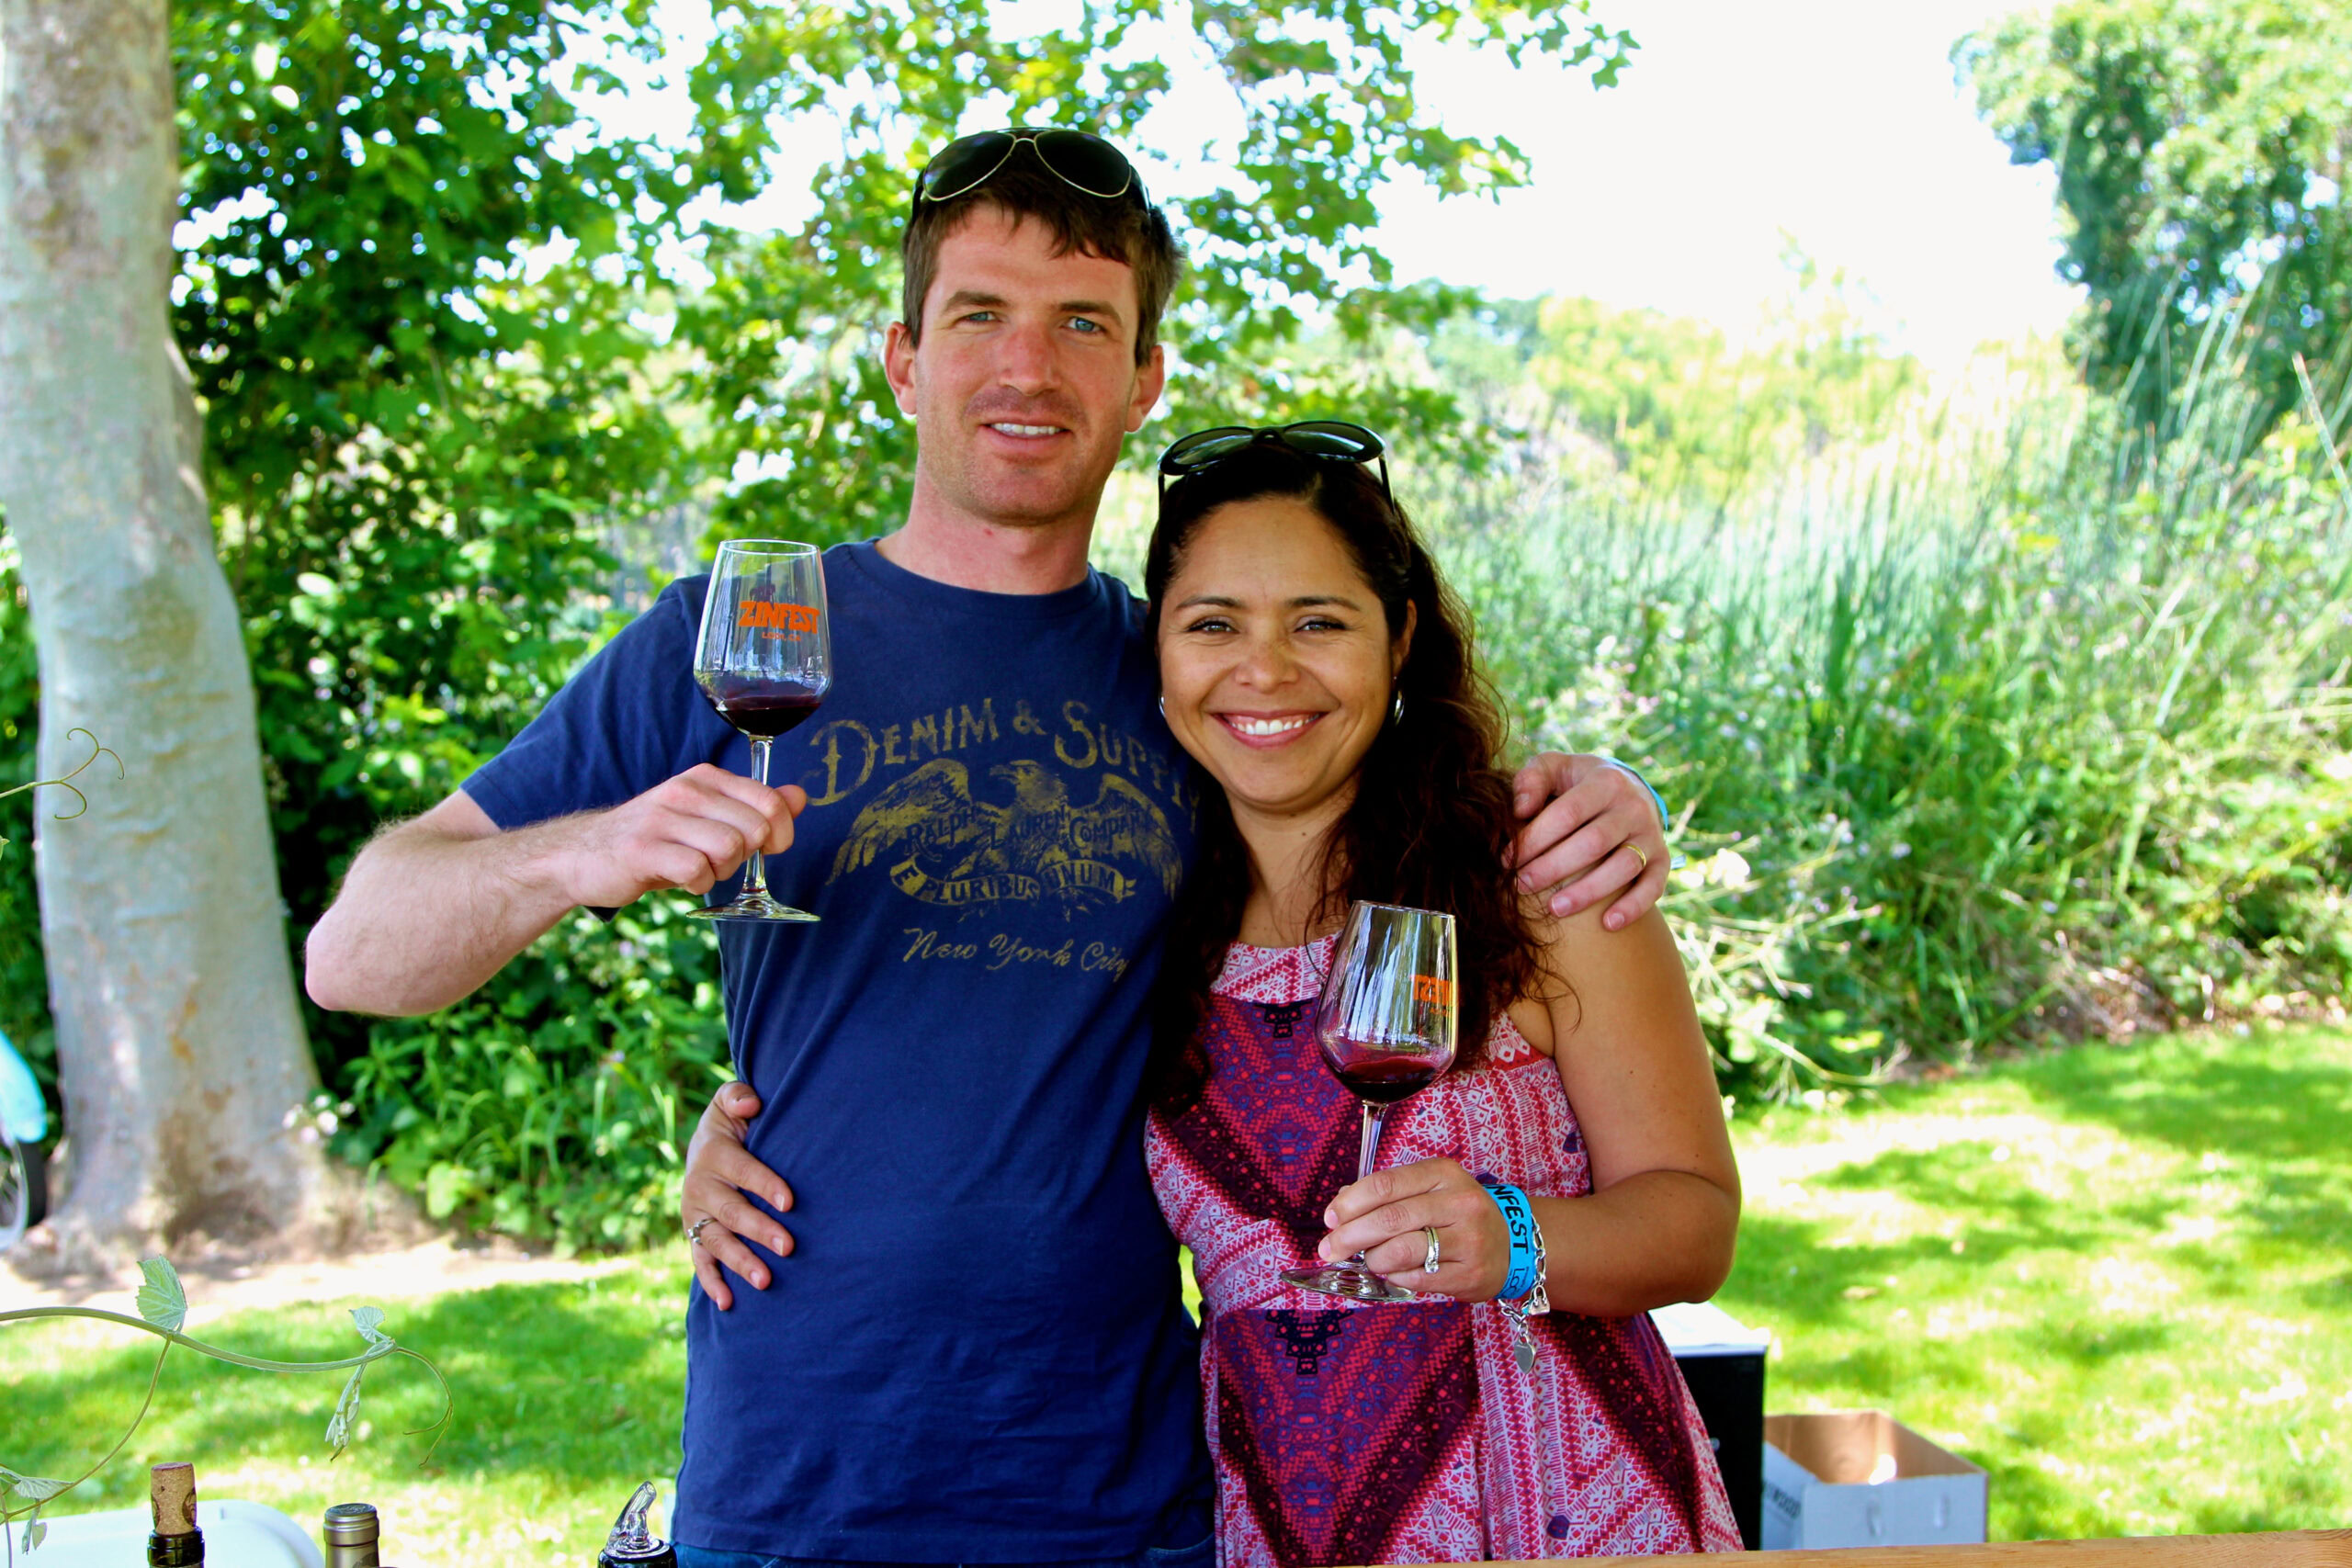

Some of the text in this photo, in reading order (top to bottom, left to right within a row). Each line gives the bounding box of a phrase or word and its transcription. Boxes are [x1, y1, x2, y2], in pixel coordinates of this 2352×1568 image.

[738, 600, 820, 635] ZINFEST
[802, 698, 1000, 807] DENIM
[1012, 699, 1047, 735] &
[904, 806, 976, 862] RALPH
[989, 802, 1069, 850] LAUREN
[894, 861, 1116, 903] E PLURIBUS UNUM
[903, 928, 1131, 983] New York City
[1482, 1183, 1529, 1255] NFEST
